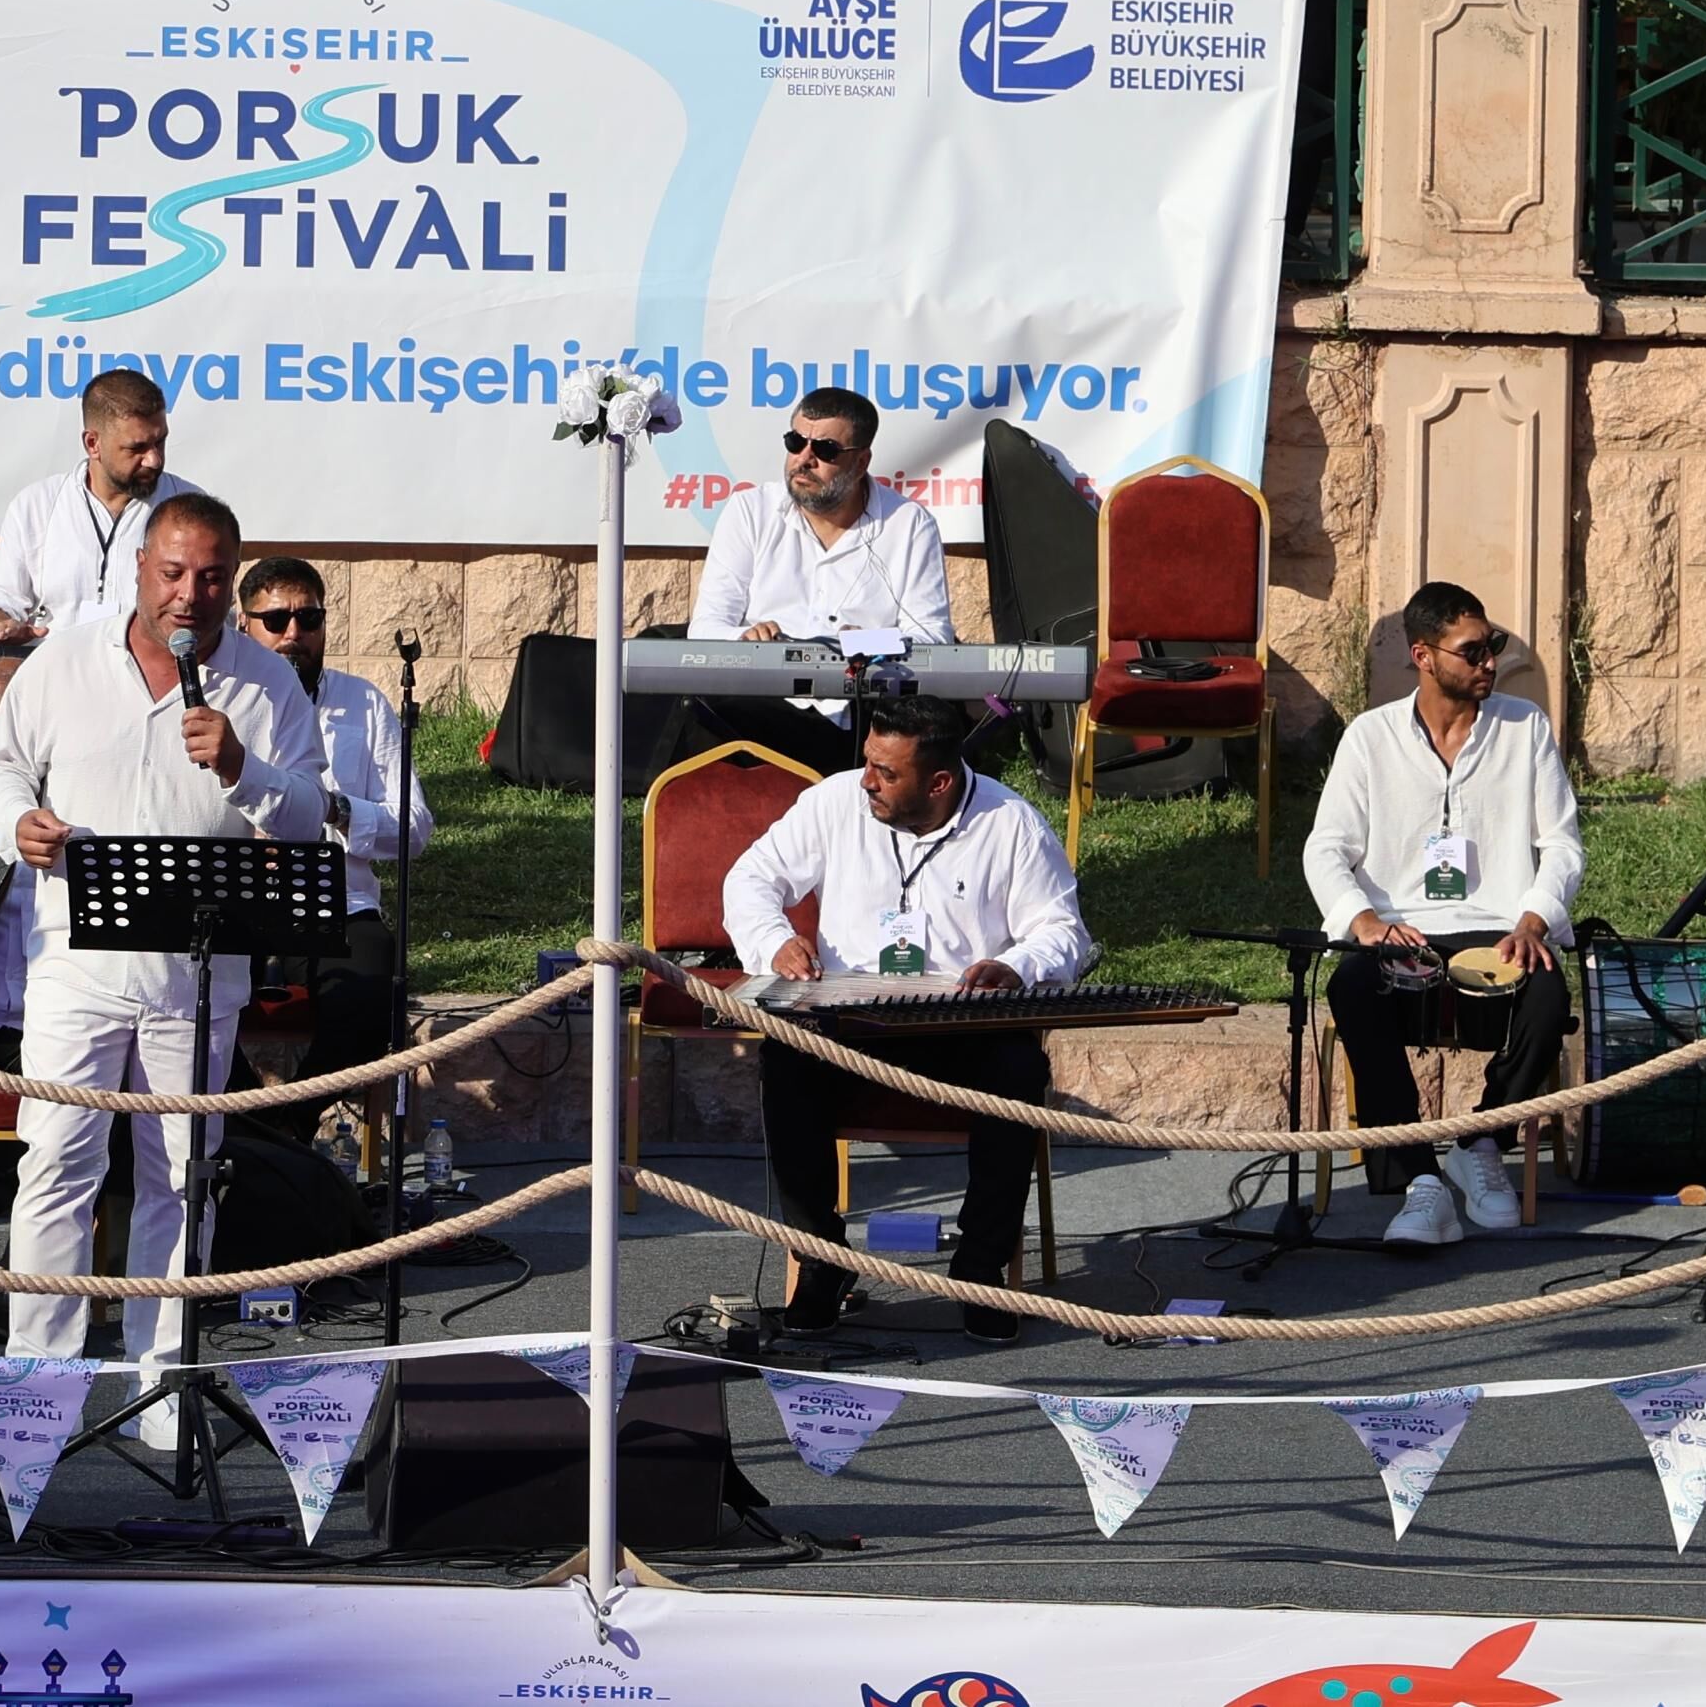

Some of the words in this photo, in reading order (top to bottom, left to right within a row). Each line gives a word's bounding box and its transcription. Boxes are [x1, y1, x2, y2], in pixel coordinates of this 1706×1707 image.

[760, 18, 896, 61] ÜNLÜCE
[1110, 31, 1267, 62] BÜYÜKŞEHİR
[1110, 64, 1245, 93] BELEDİYESİ
[58, 84, 541, 169] PORSUK
[752, 351, 1148, 421] buluşuyor.
[988, 647, 1056, 672] KORG
[273, 1401, 346, 1412] PORSUK
[541, 1654, 630, 1681] ULUSLARARASI
